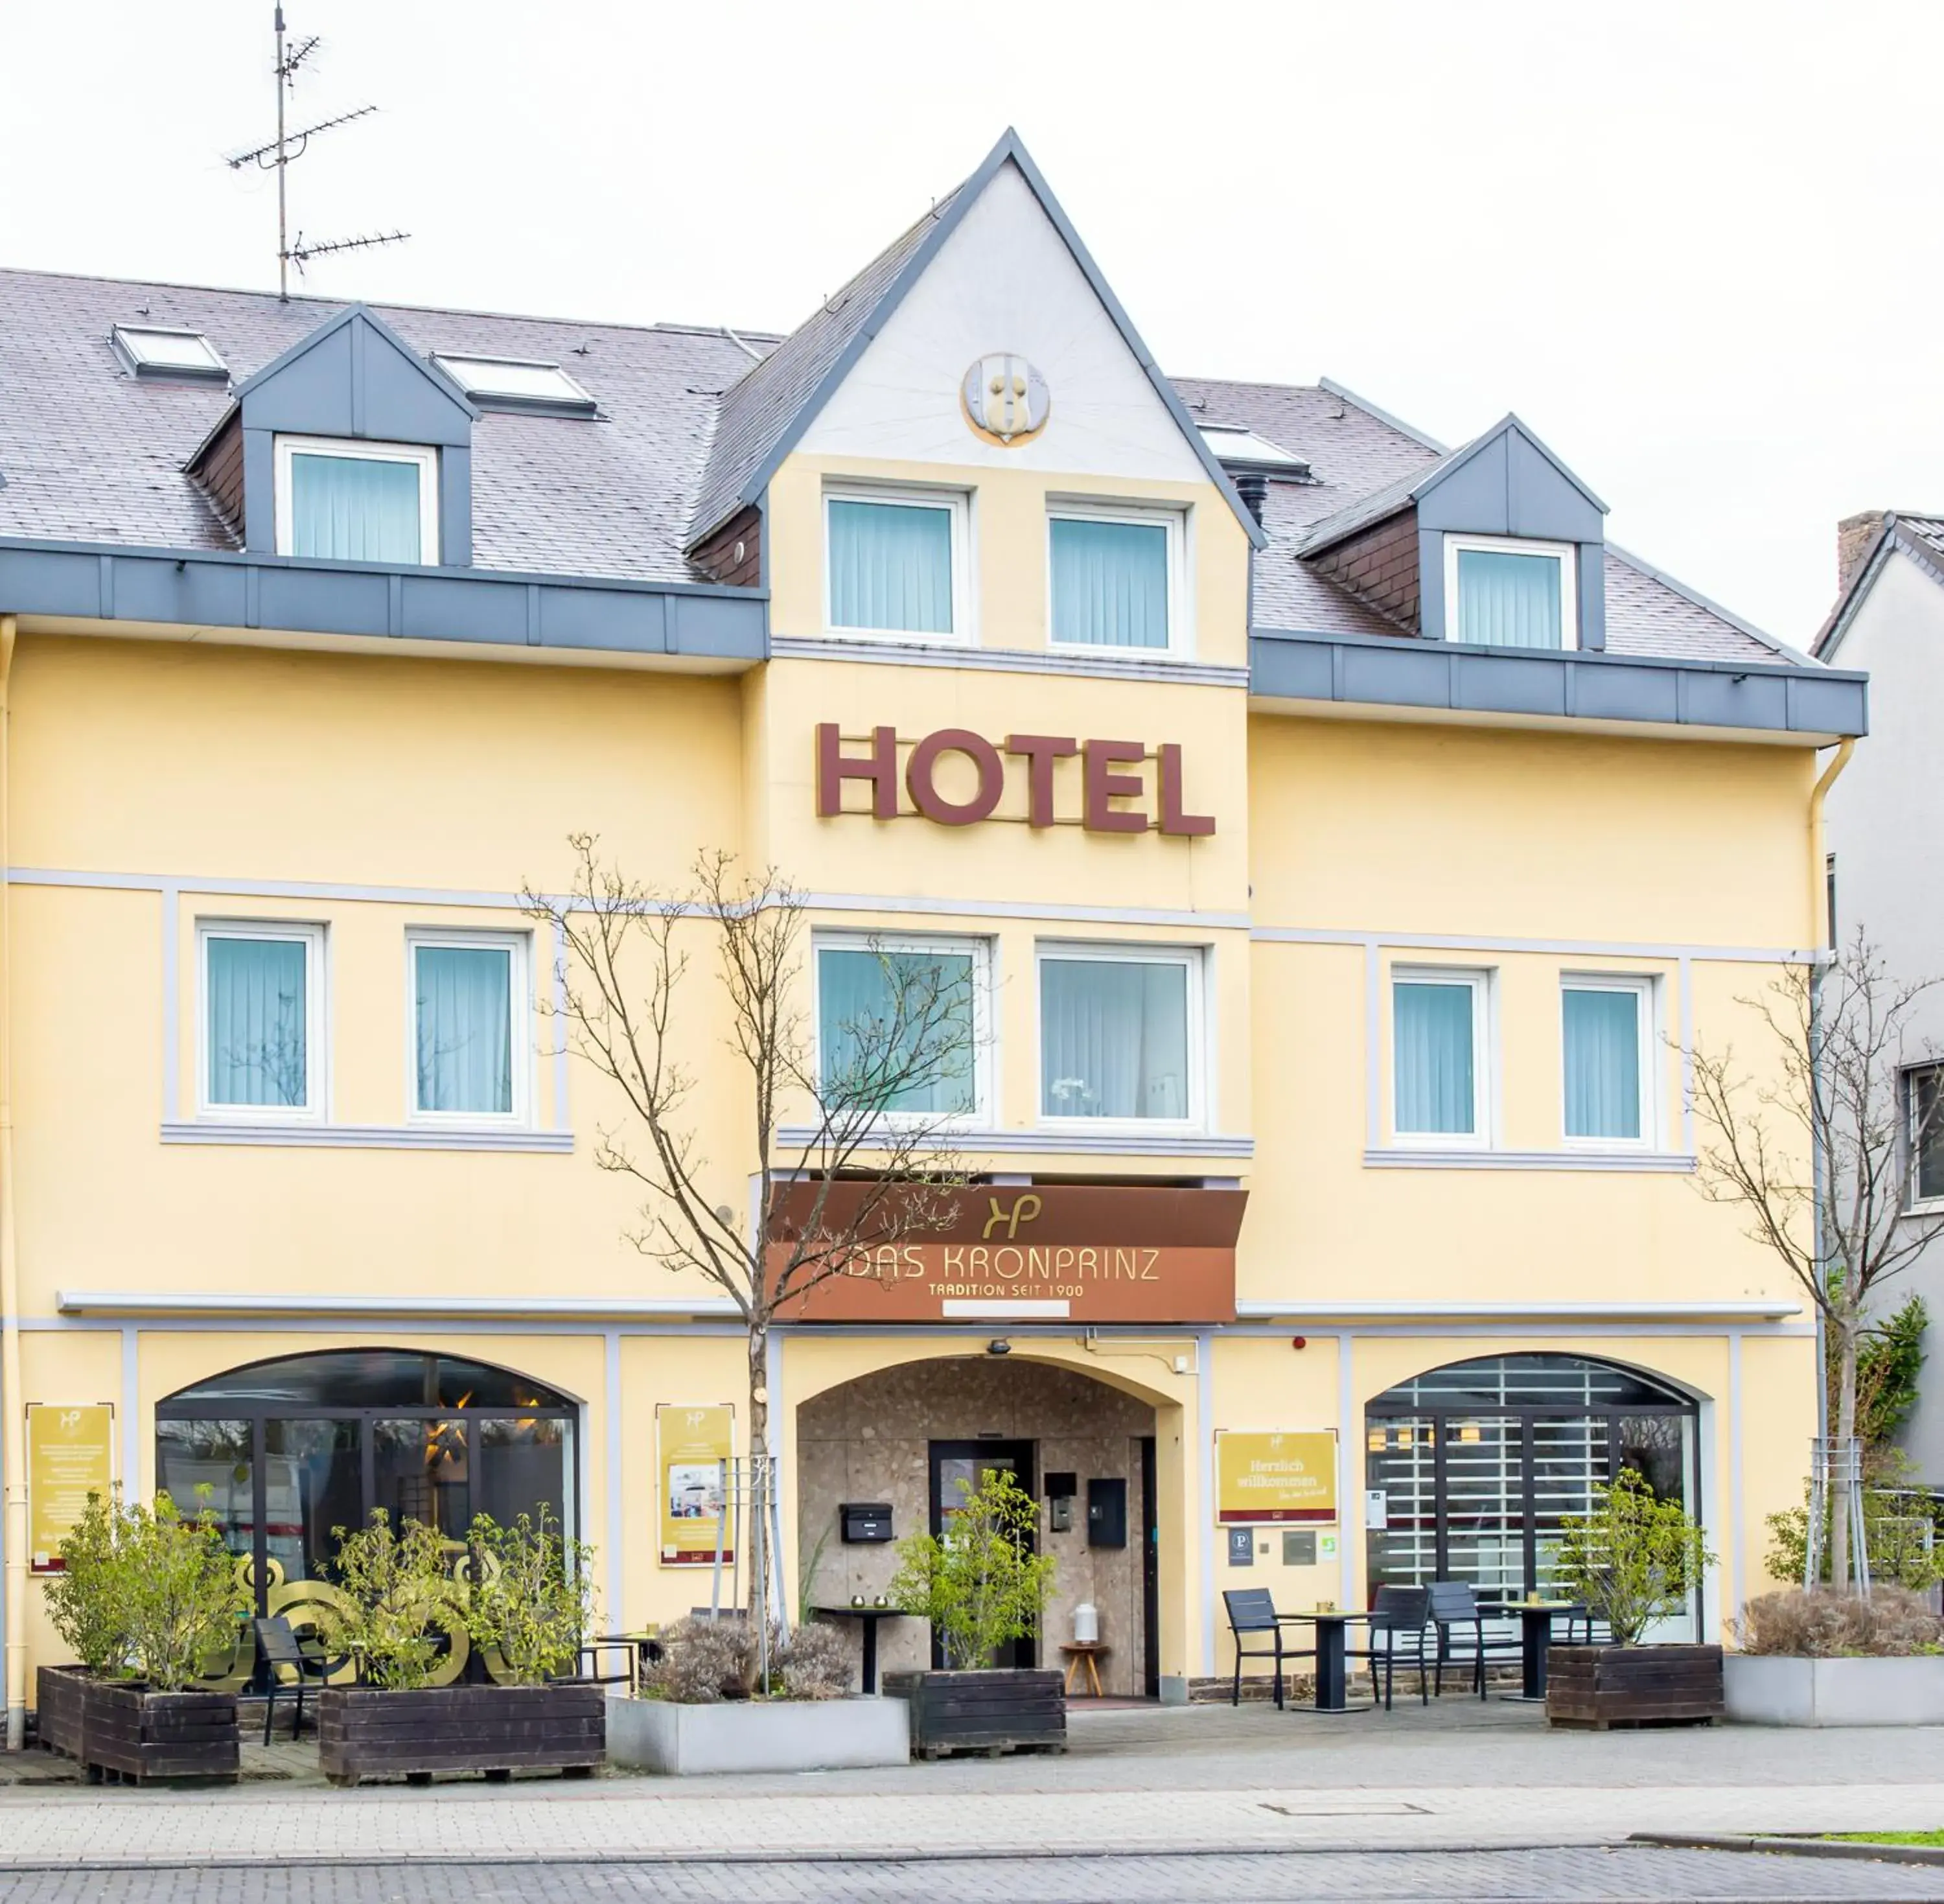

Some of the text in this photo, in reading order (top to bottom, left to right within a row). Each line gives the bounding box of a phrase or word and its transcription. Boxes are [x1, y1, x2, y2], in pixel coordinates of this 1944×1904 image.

[816, 723, 1216, 835] HOTEL
[848, 1246, 1160, 1280] DAS KRONPRINZ
[929, 1284, 1083, 1297] TRADITION SEIT 1900
[1251, 1459, 1304, 1472] Herzlich
[1237, 1474, 1317, 1488] willkommen
